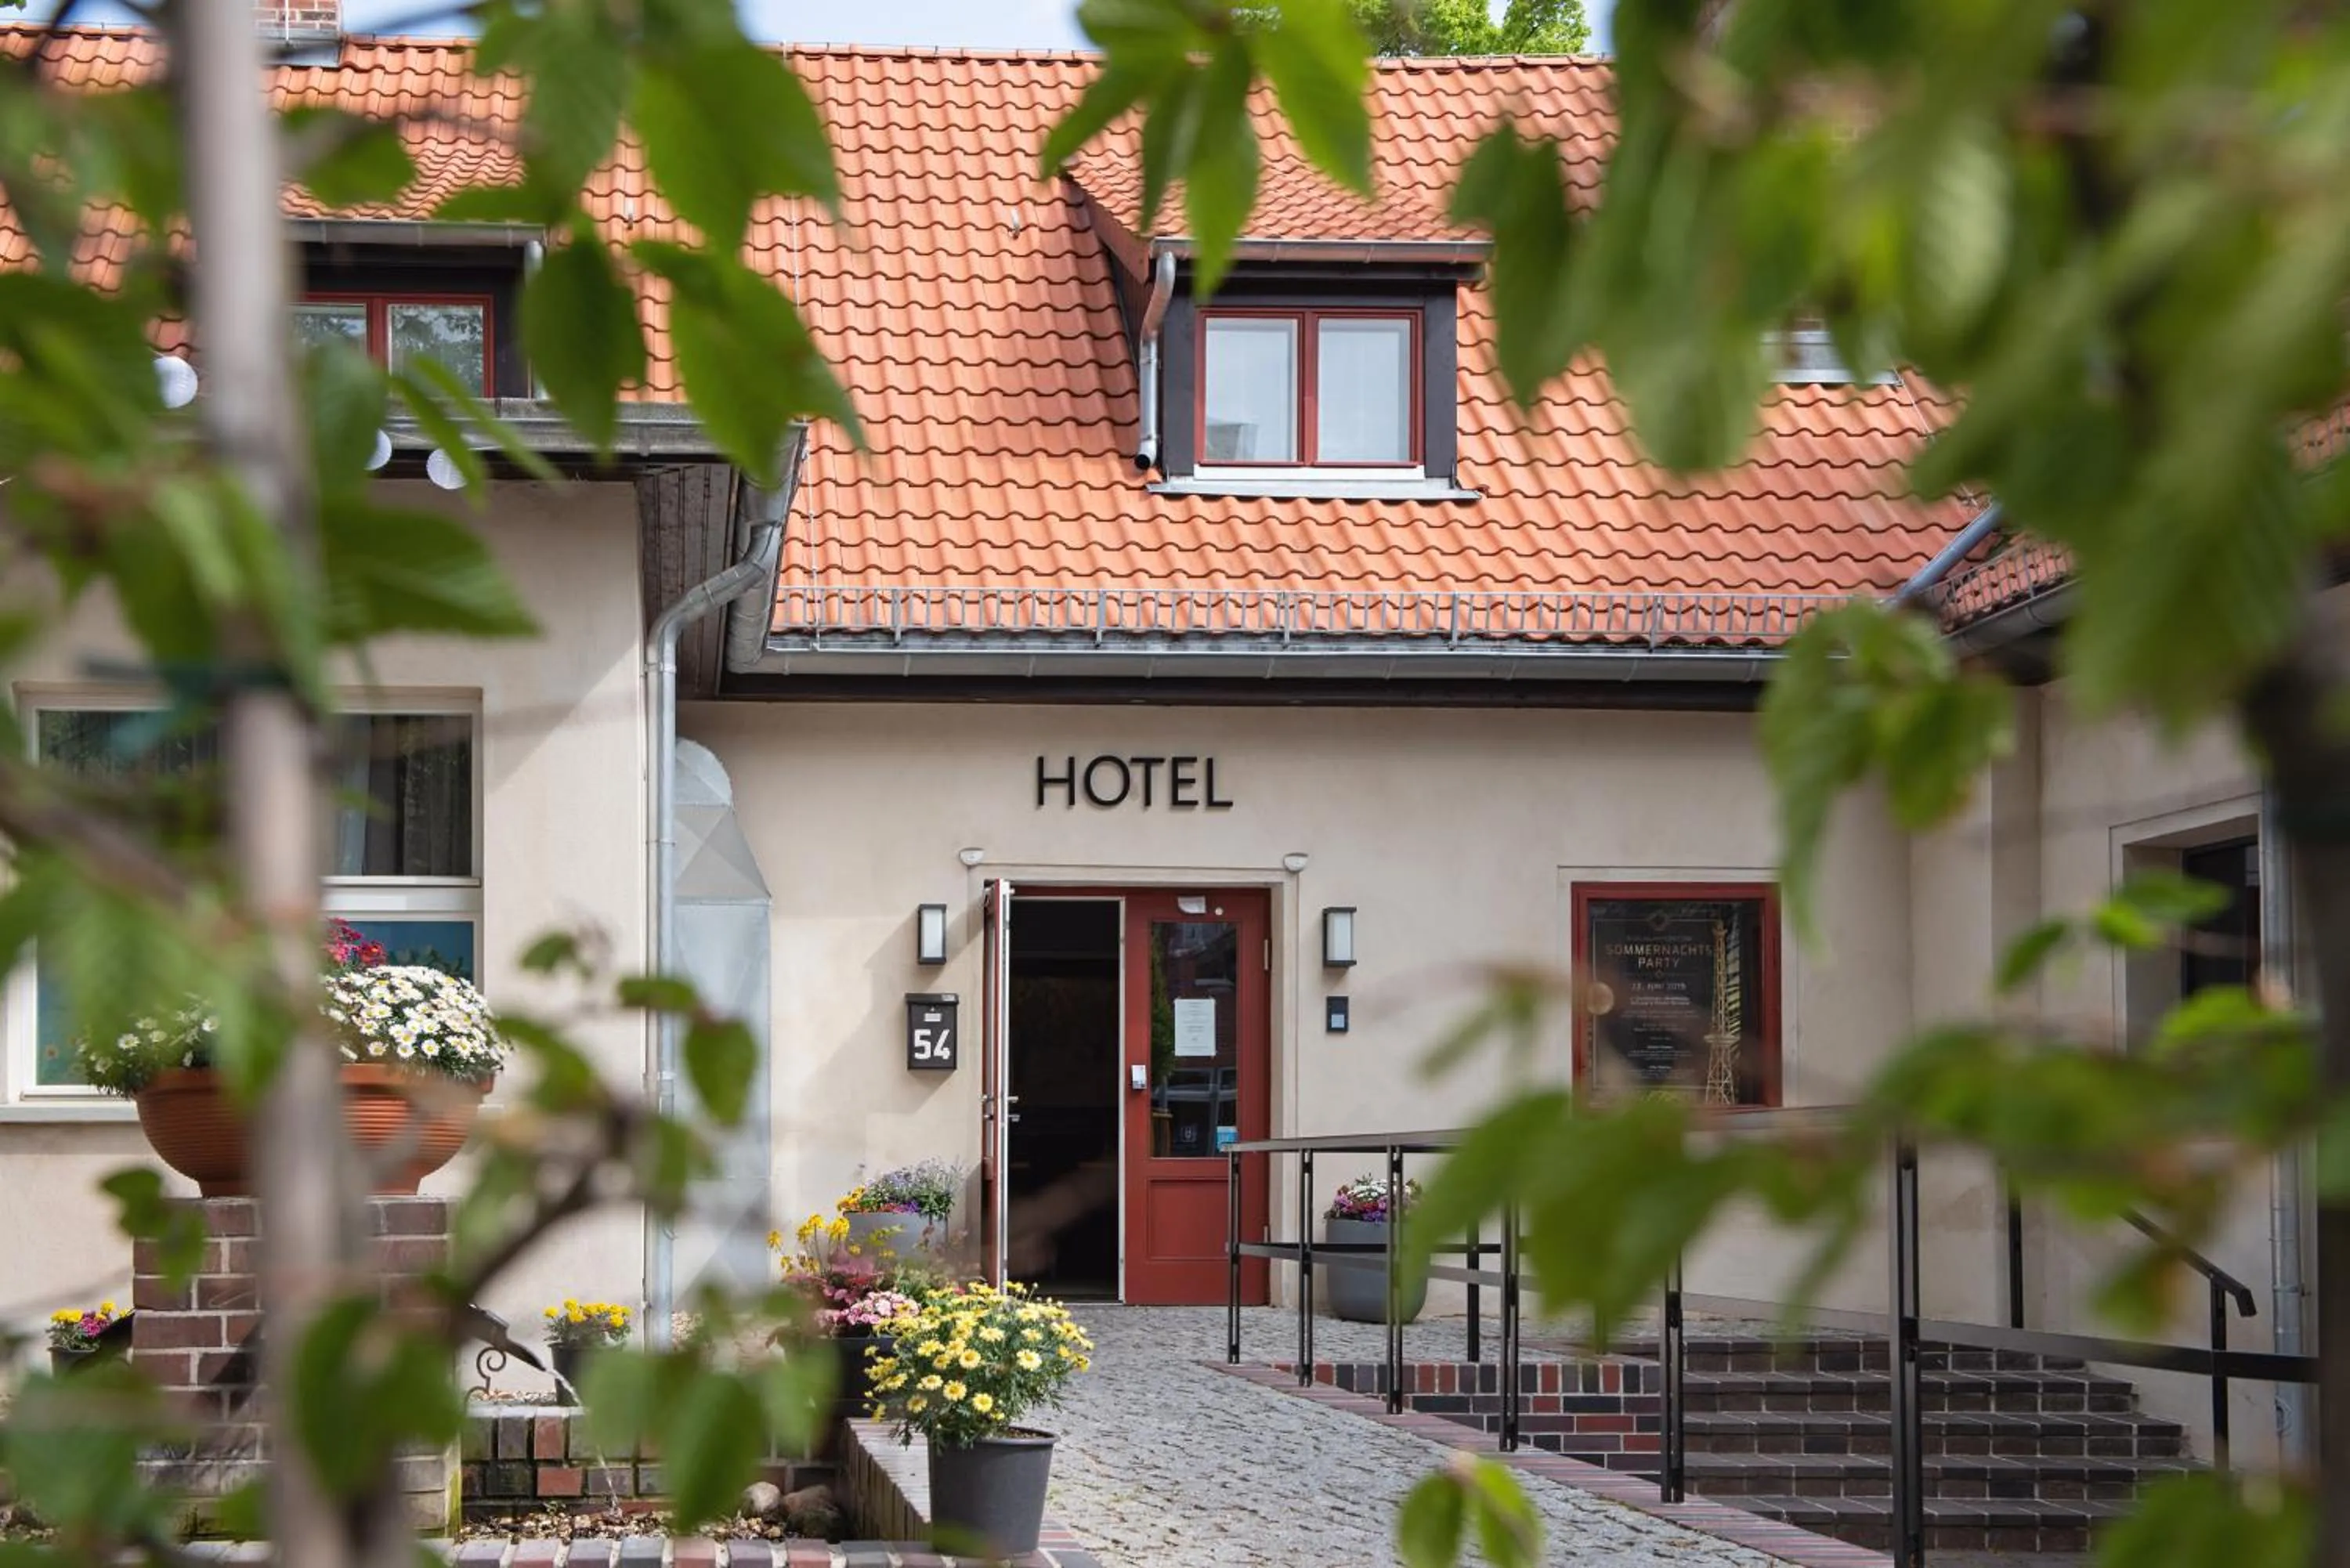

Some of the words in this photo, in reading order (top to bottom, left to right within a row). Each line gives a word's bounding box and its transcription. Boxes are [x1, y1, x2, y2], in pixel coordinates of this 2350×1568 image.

[1037, 755, 1234, 807] HOTEL
[1638, 956, 1680, 969] PARTY
[914, 1028, 950, 1060] 54
